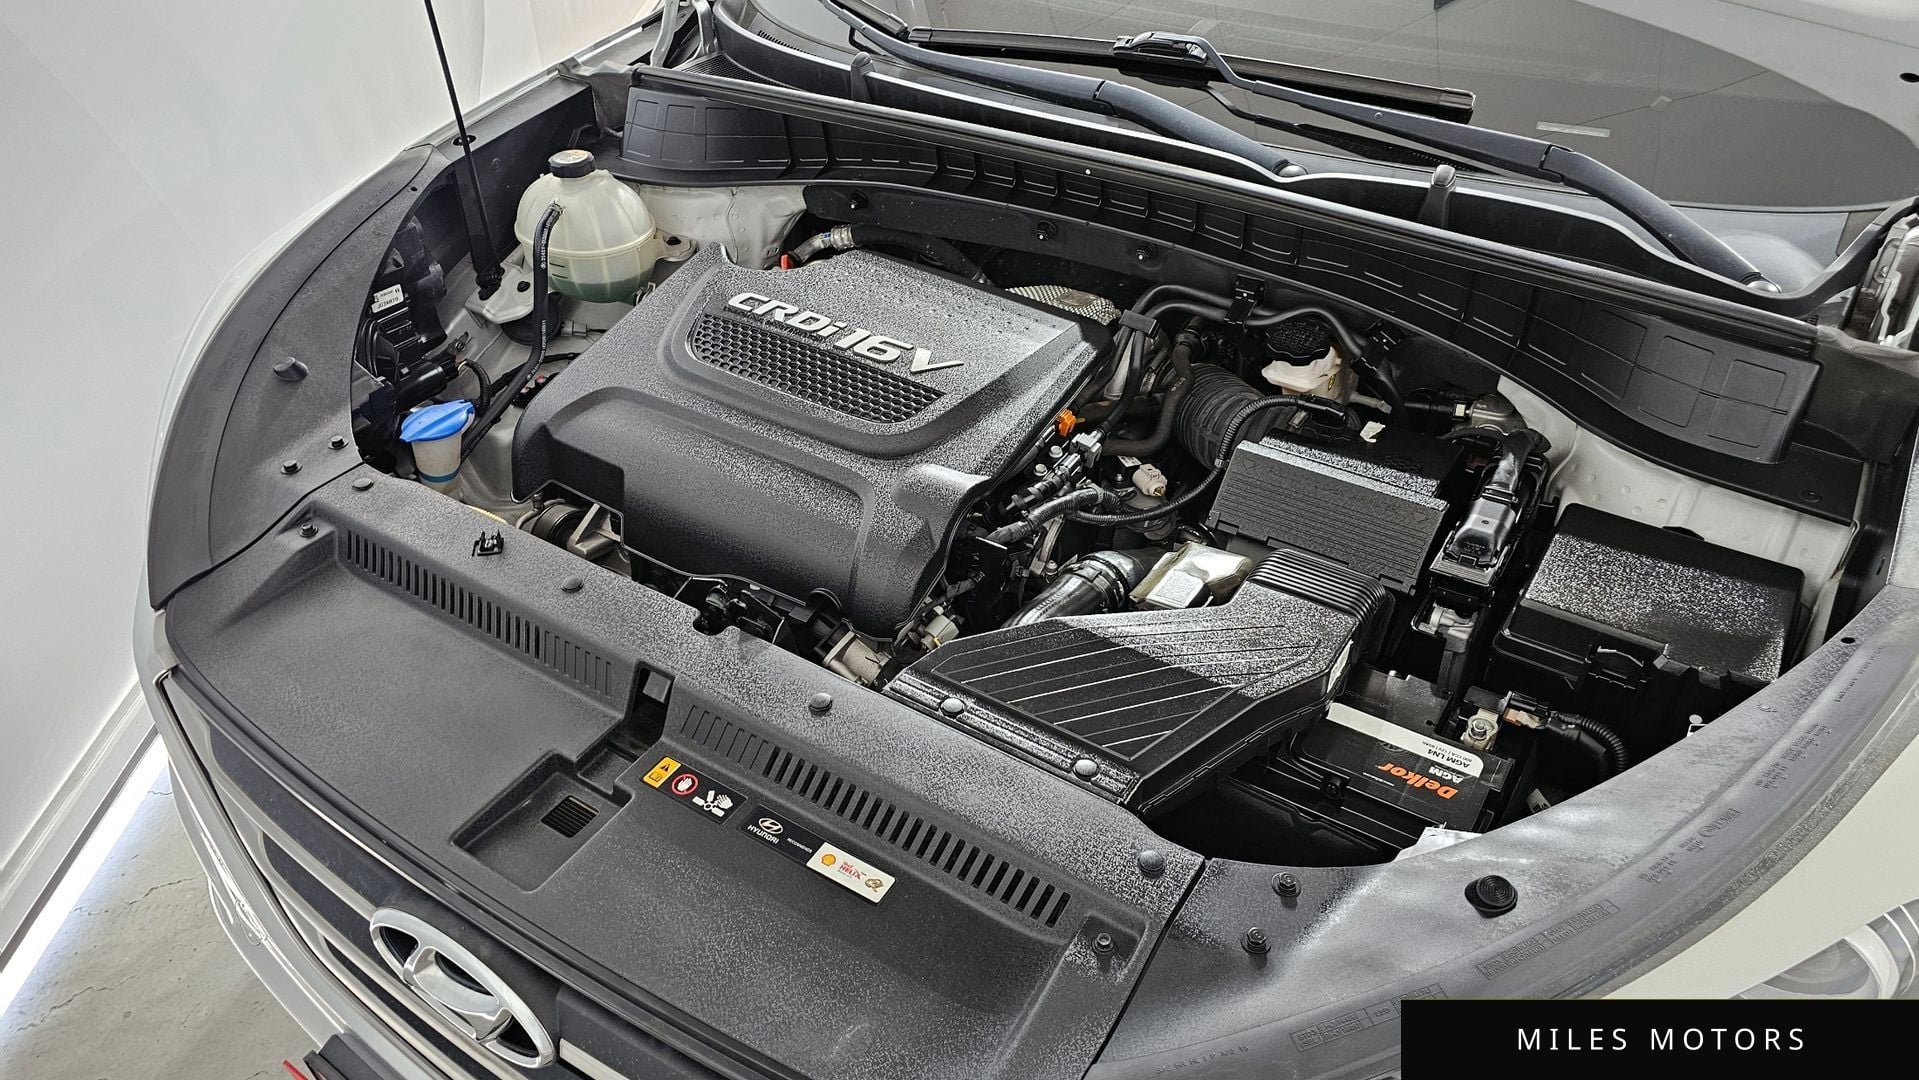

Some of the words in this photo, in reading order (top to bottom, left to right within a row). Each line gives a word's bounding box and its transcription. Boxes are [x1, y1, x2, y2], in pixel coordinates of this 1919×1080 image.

[1427, 748, 1446, 760] LN4
[1446, 756, 1471, 768] AGM
[1377, 762, 1459, 799] Delkor
[1428, 765, 1465, 784] AGM
[747, 824, 780, 845] HYUNDAI
[839, 864, 862, 880] HELIX
